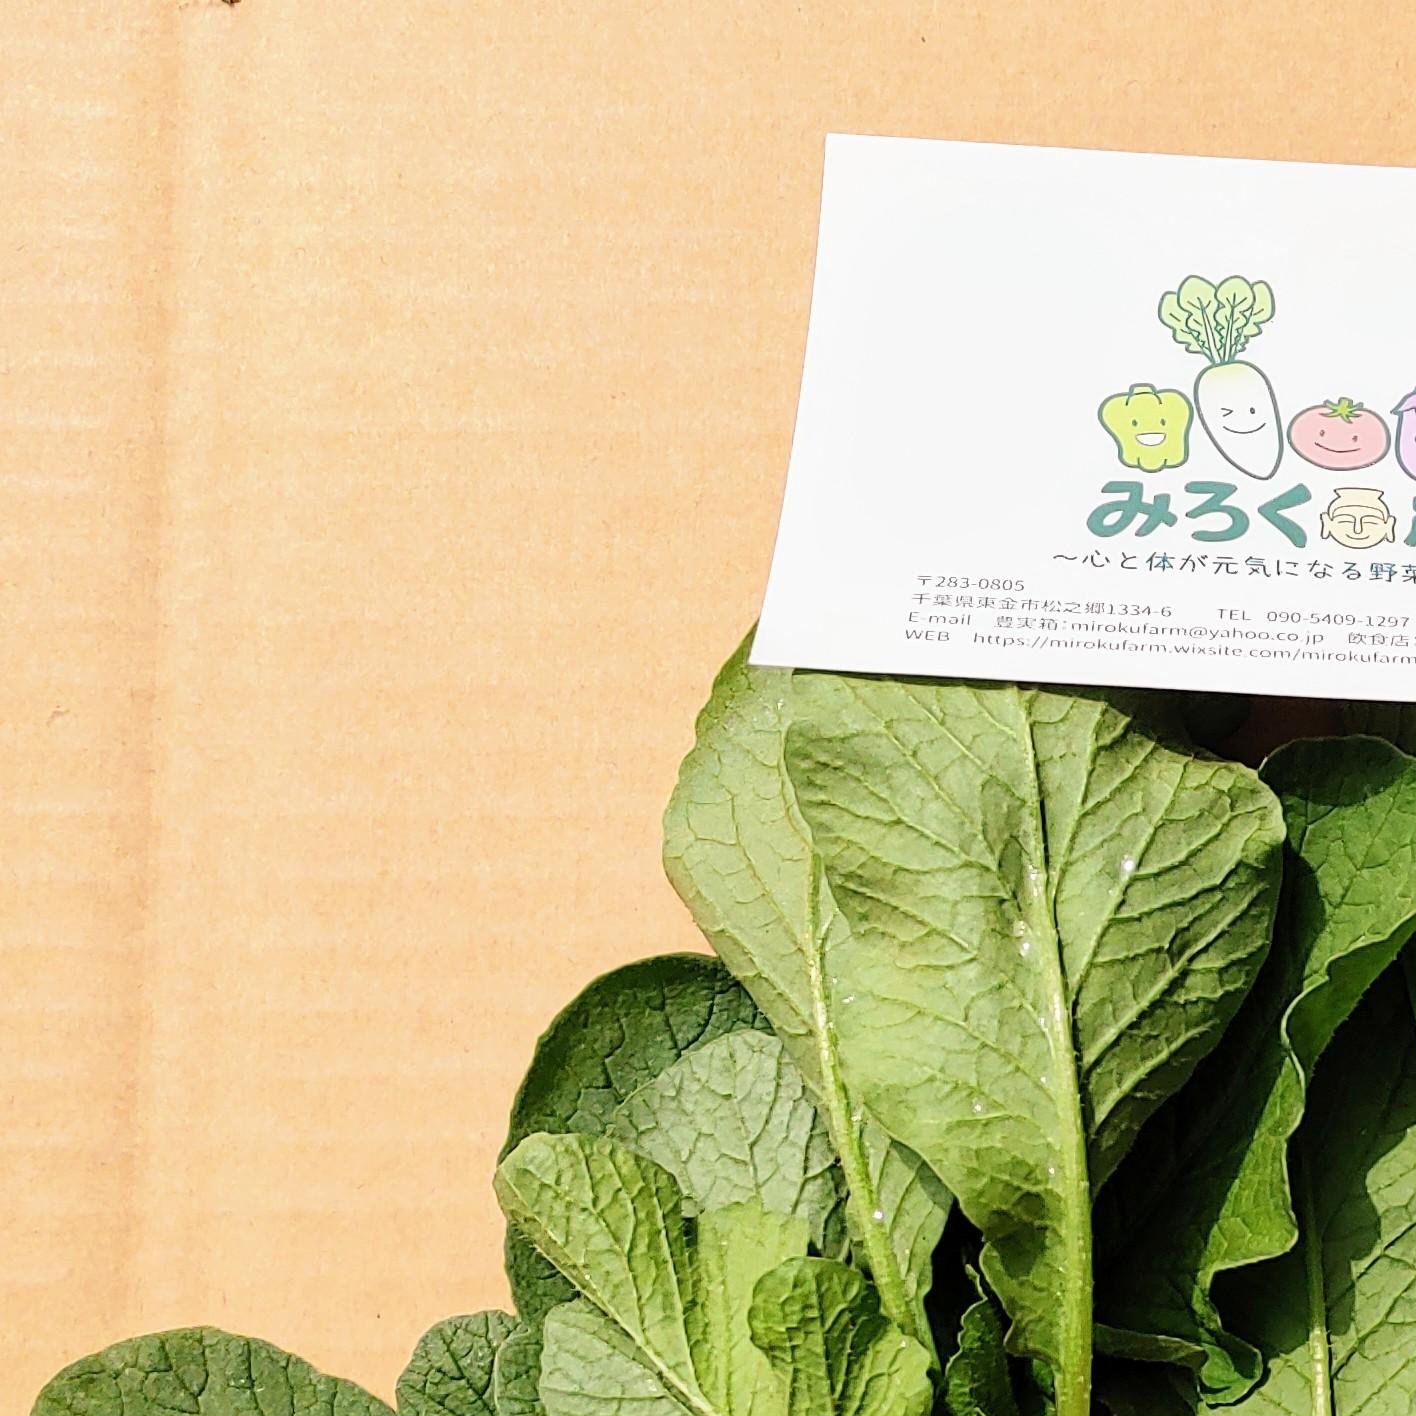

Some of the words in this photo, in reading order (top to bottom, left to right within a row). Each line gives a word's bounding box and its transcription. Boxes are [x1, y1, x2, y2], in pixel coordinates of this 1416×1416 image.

[1087, 480, 1312, 548] みろく
[908, 611, 972, 626] E-mail
[1217, 608, 1253, 621] TEL
[1267, 611, 1410, 628] 090-5409-1297
[905, 629, 951, 642] WEB
